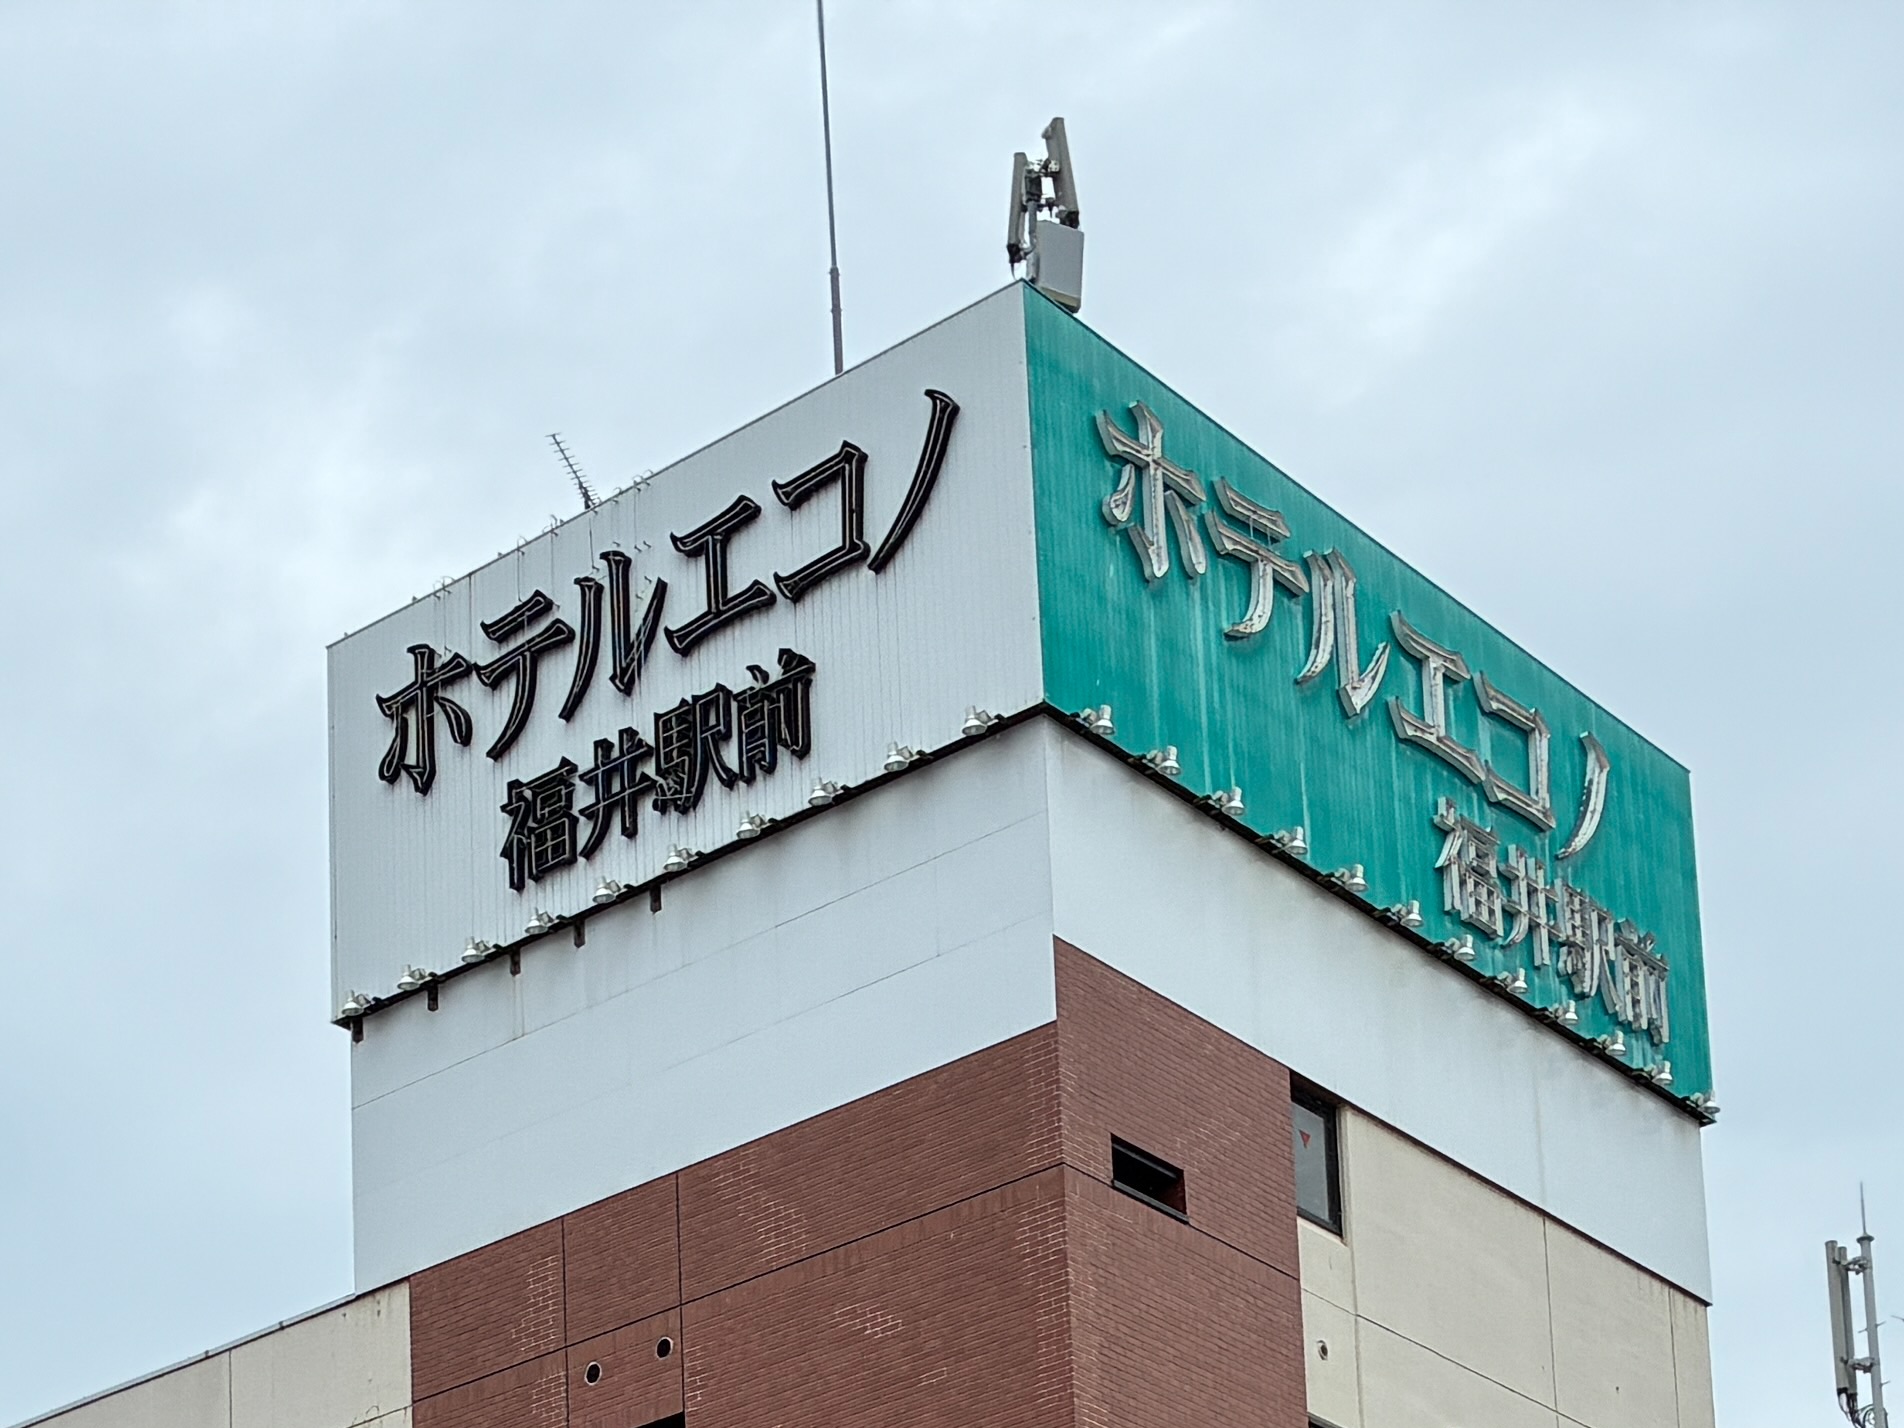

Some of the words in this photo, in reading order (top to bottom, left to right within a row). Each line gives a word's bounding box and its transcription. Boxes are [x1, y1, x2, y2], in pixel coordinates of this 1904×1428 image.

[376, 388, 959, 795] ホテルエコノ
[1096, 400, 1611, 862] ホテルエコノ
[501, 648, 814, 892] 福井駅前
[1433, 795, 1669, 1047] 福井駅前
